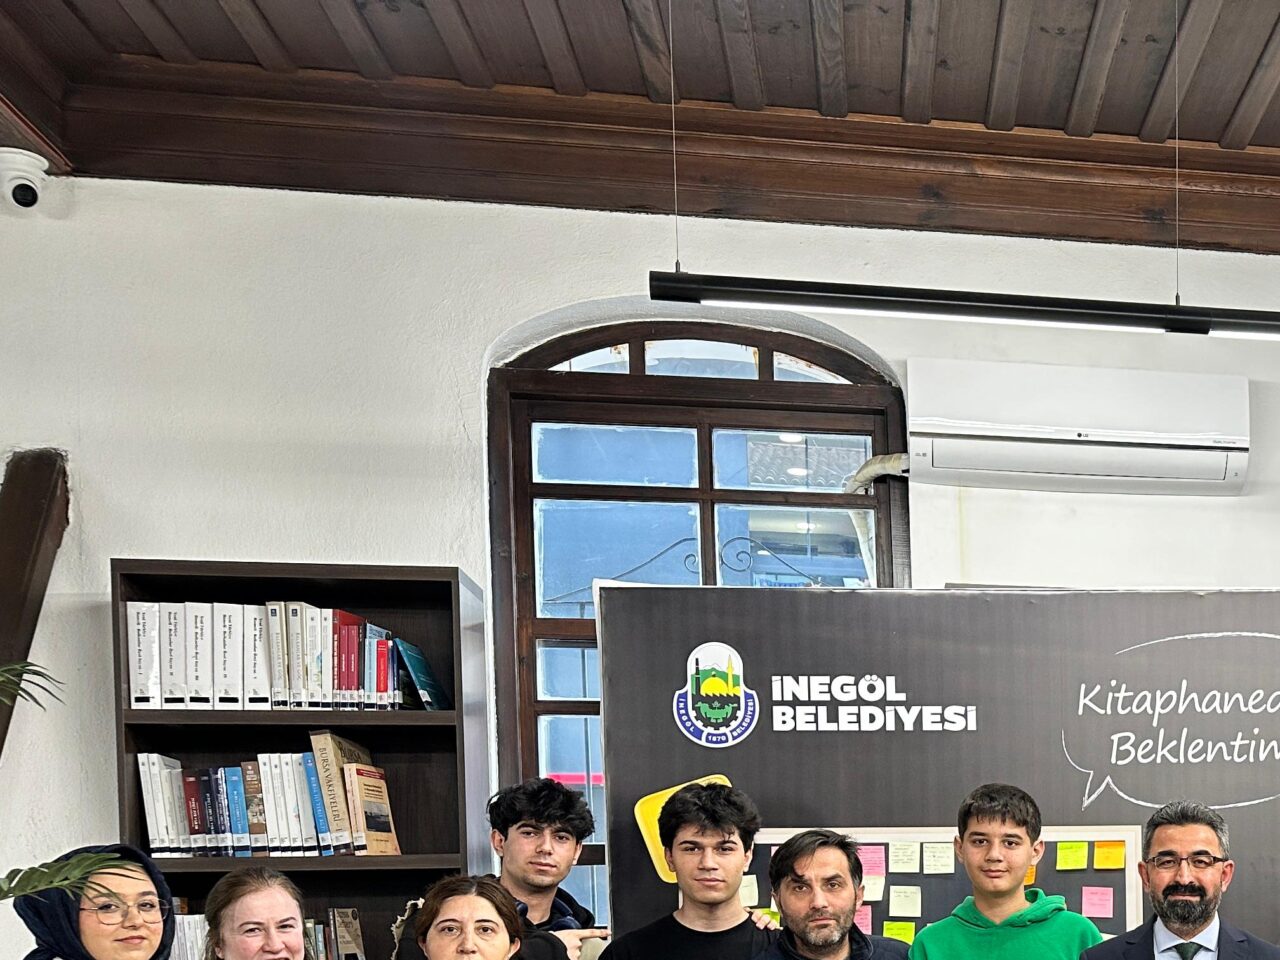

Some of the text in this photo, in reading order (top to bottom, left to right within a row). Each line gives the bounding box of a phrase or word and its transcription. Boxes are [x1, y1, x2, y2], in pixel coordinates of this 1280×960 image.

[772, 674, 906, 702] İNEGÖL
[773, 705, 977, 731] BELEDİYESİ
[319, 747, 330, 773] BURSA
